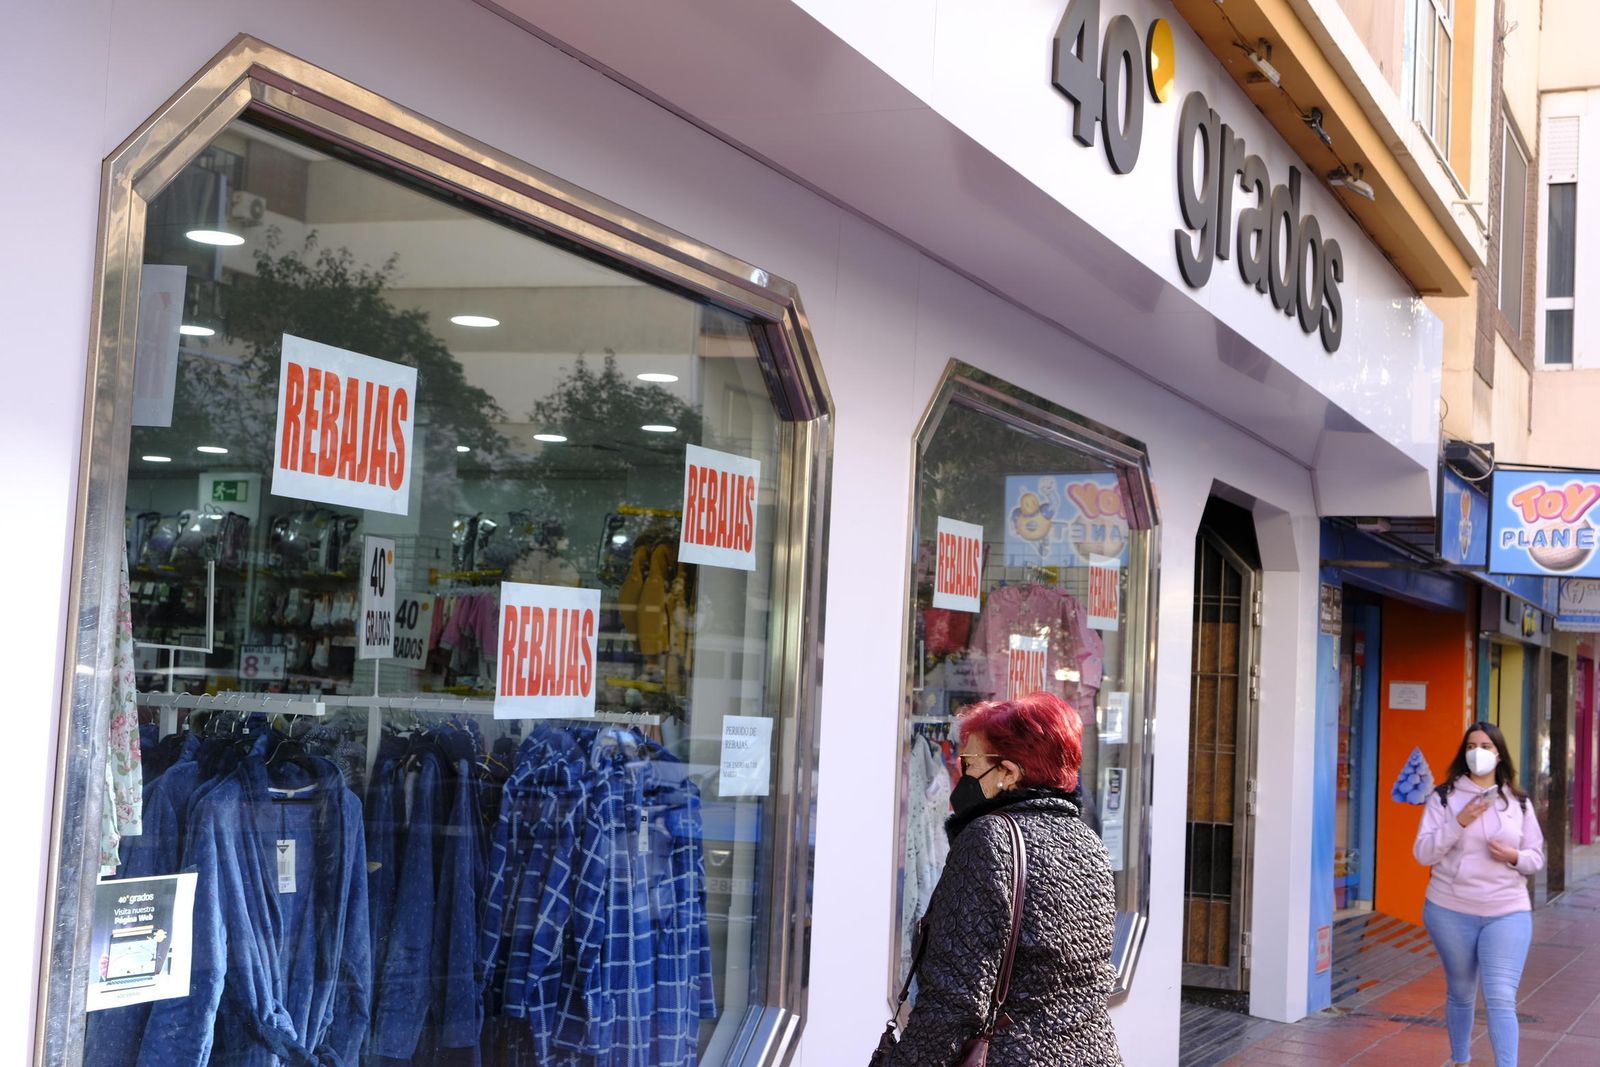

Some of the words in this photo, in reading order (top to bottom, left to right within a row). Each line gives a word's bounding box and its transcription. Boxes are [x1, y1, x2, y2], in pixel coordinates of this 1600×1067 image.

[1174, 91, 1344, 353] grados
[280, 362, 408, 491] REBAJAS
[684, 464, 755, 554] REBAJAS
[1512, 483, 1600, 524] TOY
[1502, 527, 1600, 548] PLANE
[937, 532, 980, 599] REBAJAS
[1088, 566, 1118, 620] REBAJAS
[366, 609, 392, 646] GRADOS
[394, 637, 424, 660] RADOS
[500, 604, 594, 698] REBAJAS
[114, 907, 132, 916] Visita
[132, 906, 155, 915] nuestra
[129, 893, 154, 904] grados
[139, 914, 153, 922] Web
